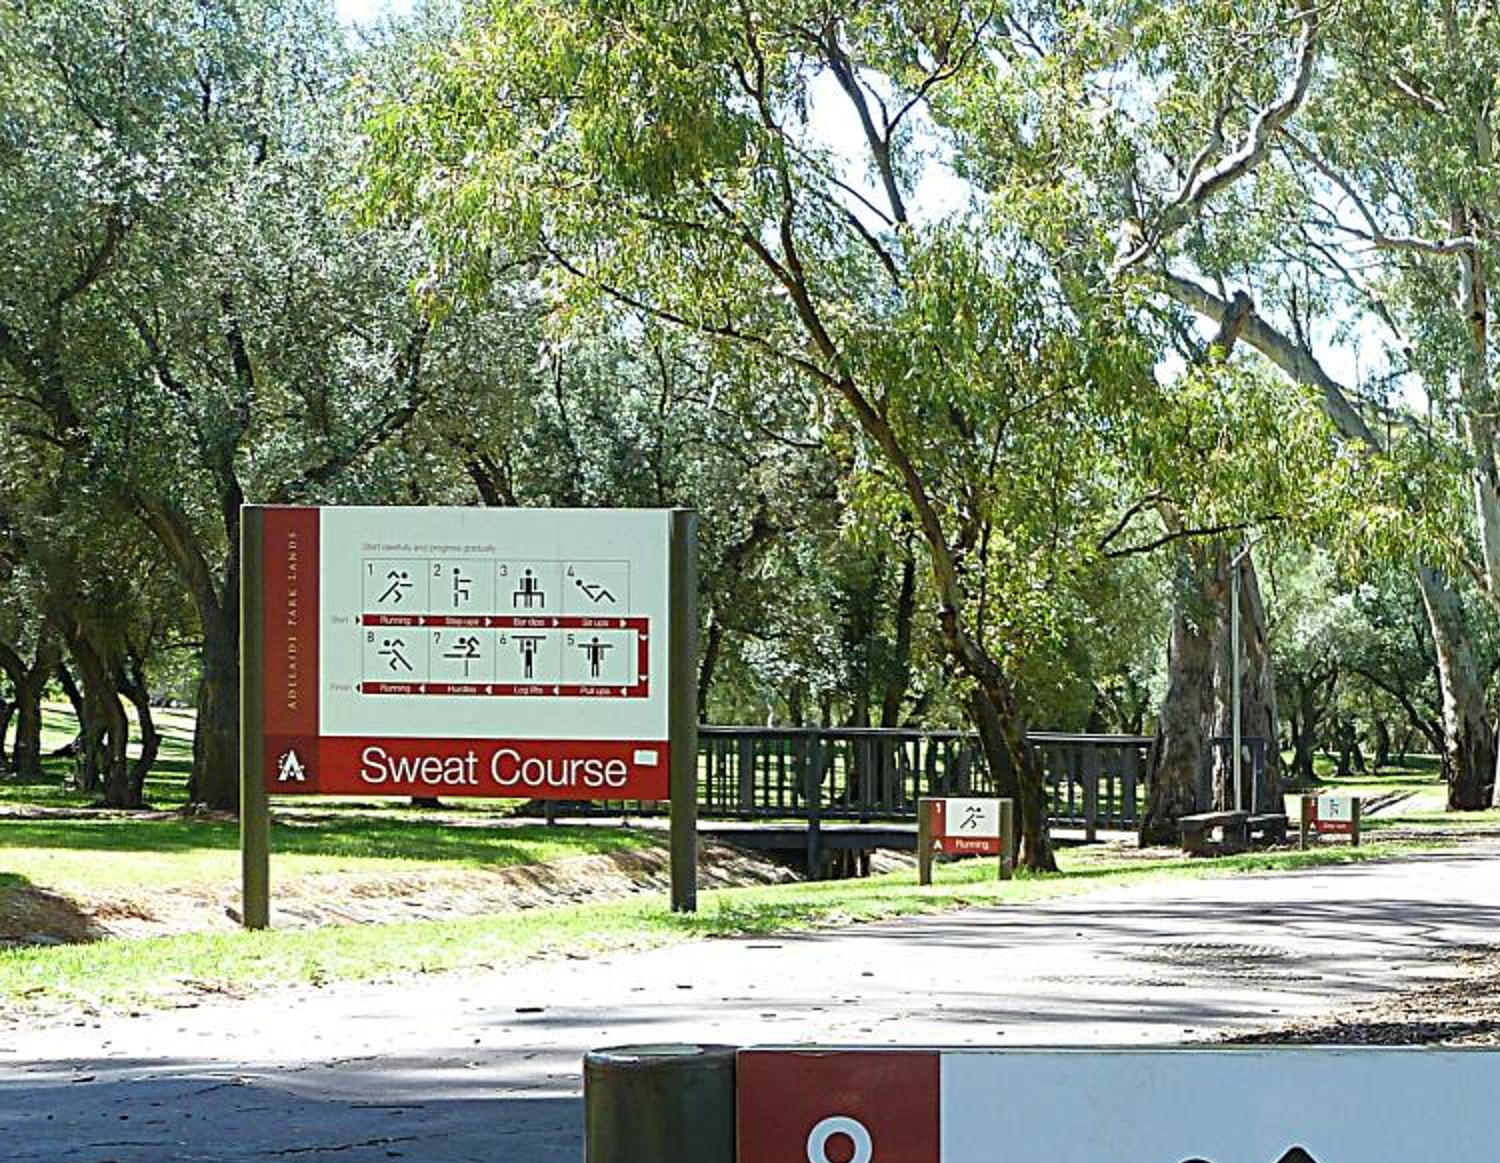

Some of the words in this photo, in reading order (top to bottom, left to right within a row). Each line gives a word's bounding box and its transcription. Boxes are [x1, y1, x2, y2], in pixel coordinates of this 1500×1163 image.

[367, 563, 374, 576] 1
[433, 564, 441, 577] 2
[500, 564, 508, 577] 3
[567, 565, 575, 577] 4
[380, 615, 411, 626] Running
[367, 631, 375, 643] 8
[434, 632, 441, 644] 7
[500, 633, 507, 645] 6
[567, 633, 575, 646] 5
[380, 683, 411, 695] Running
[360, 746, 479, 785] Sweat
[490, 748, 627, 787] Course
[955, 839, 989, 851] Running
